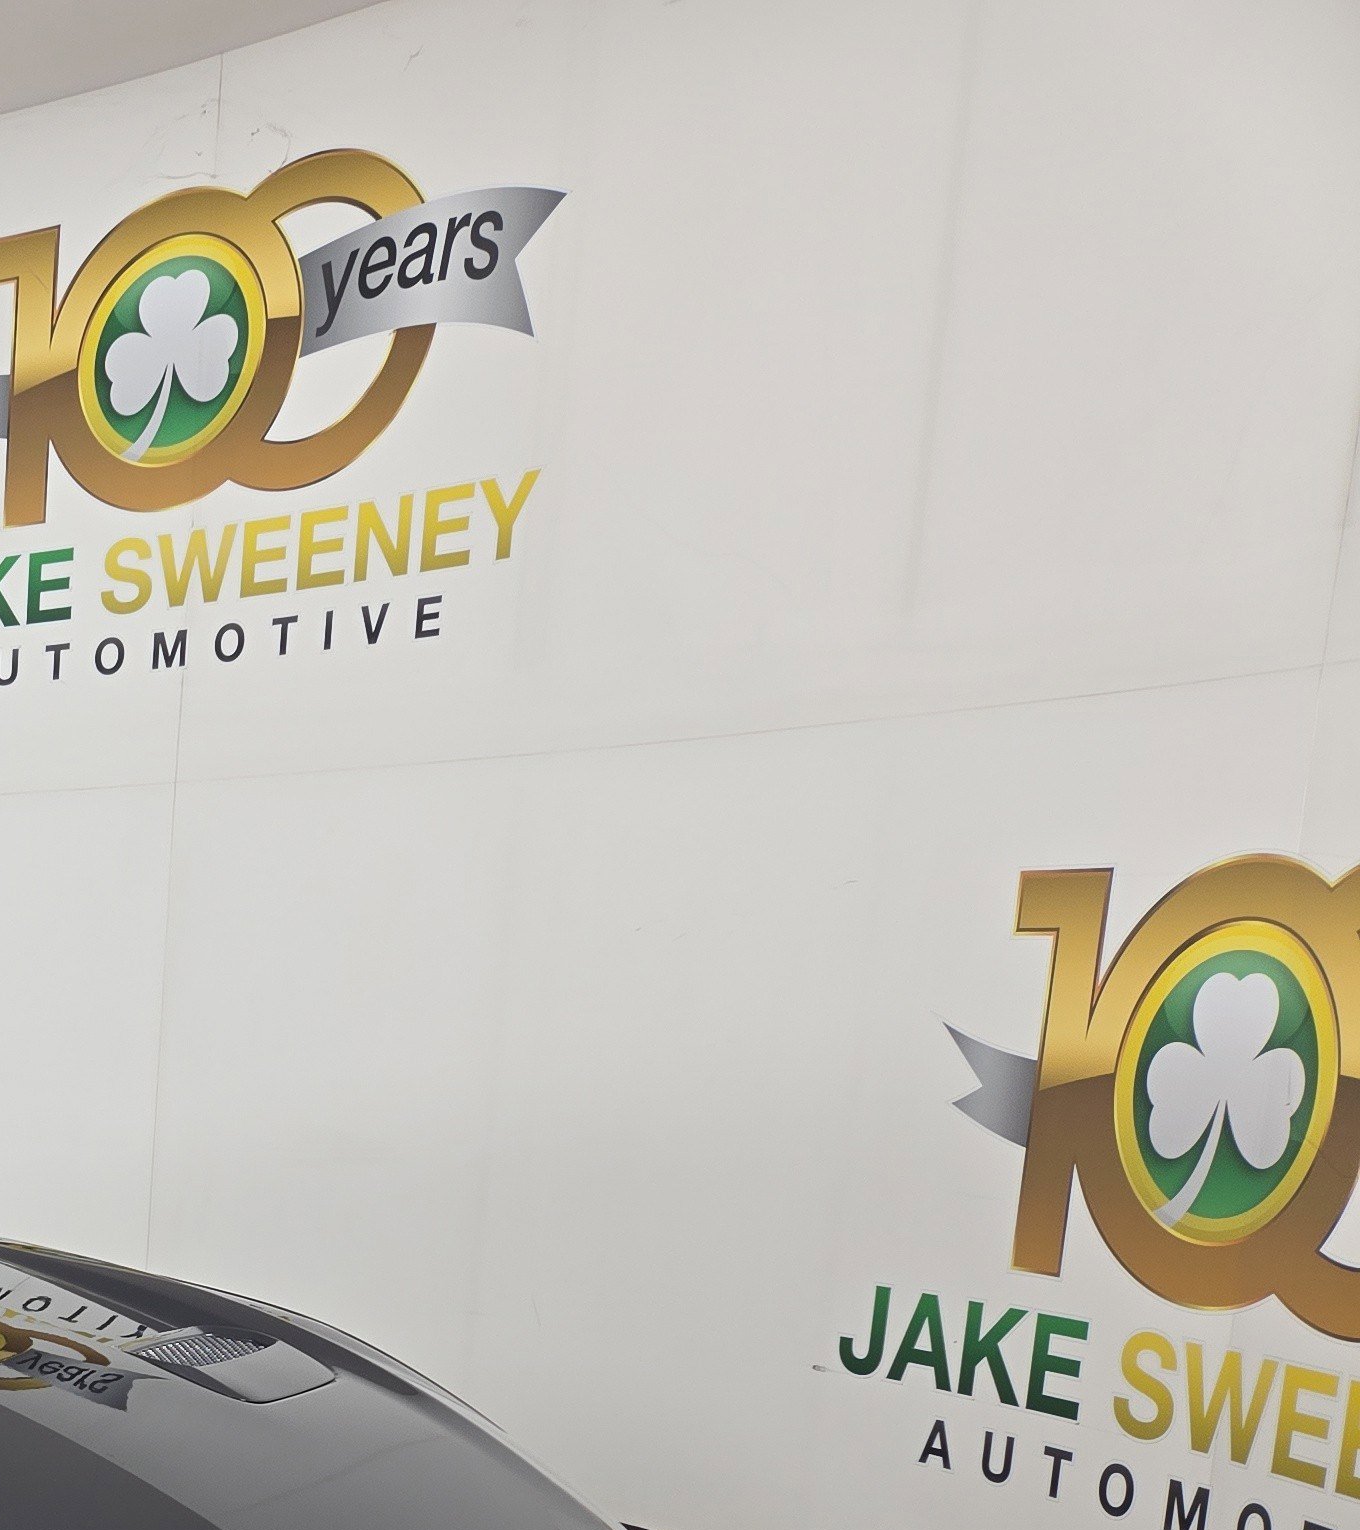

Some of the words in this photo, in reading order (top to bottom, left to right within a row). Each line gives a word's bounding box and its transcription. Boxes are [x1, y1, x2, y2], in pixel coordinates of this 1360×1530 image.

[316, 206, 504, 338] years
[100, 467, 542, 615] SWEENEY
[1011, 852, 1360, 1344] 10
[838, 1284, 1089, 1422] JAKE
